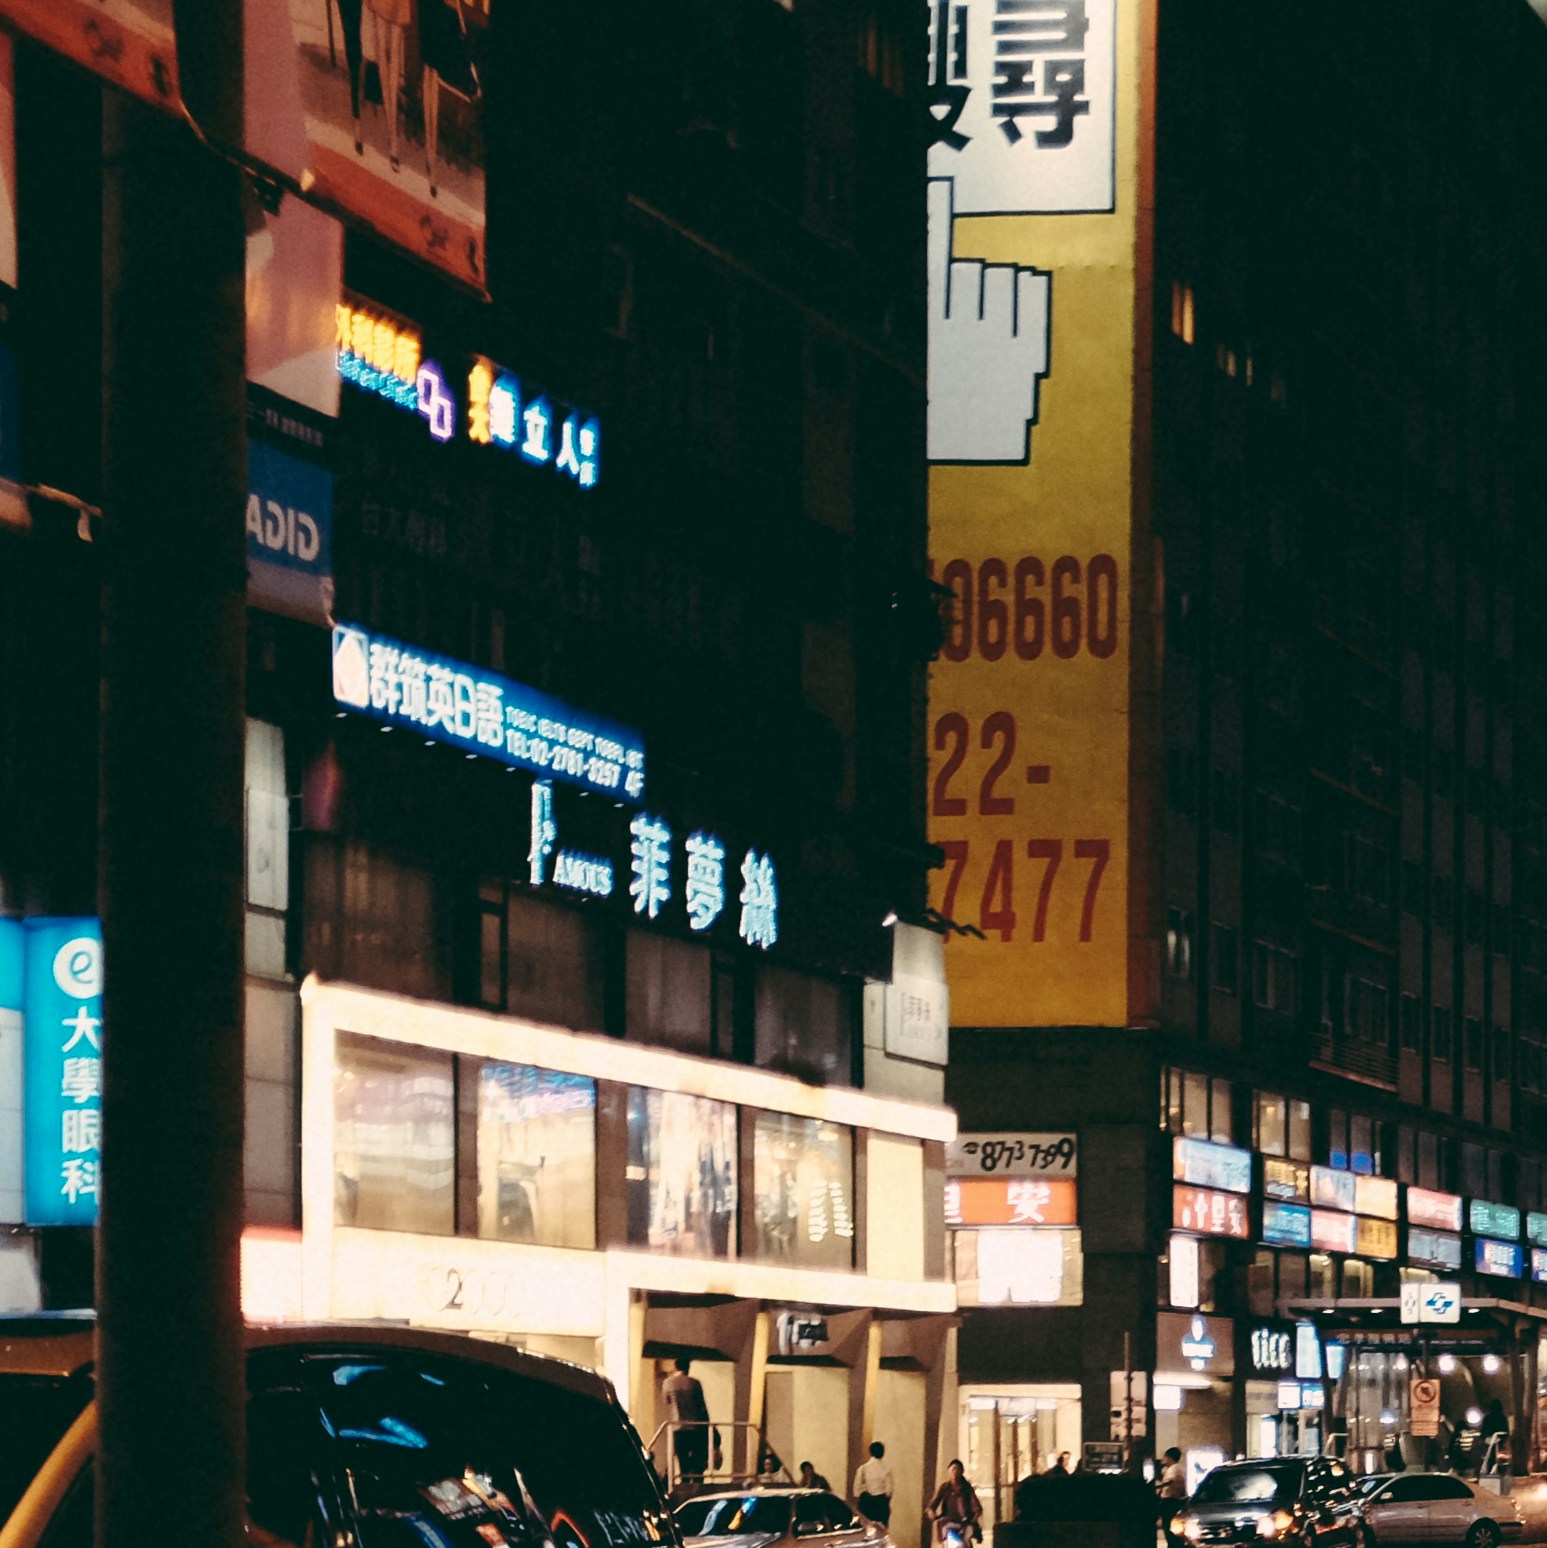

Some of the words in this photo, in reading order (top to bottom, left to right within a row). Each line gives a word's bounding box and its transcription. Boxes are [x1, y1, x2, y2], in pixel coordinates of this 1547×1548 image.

[929, 553, 1118, 662] 06660
[61, 1006, 100, 1205] 大學眼科
[981, 1140, 1025, 1172] 8773
